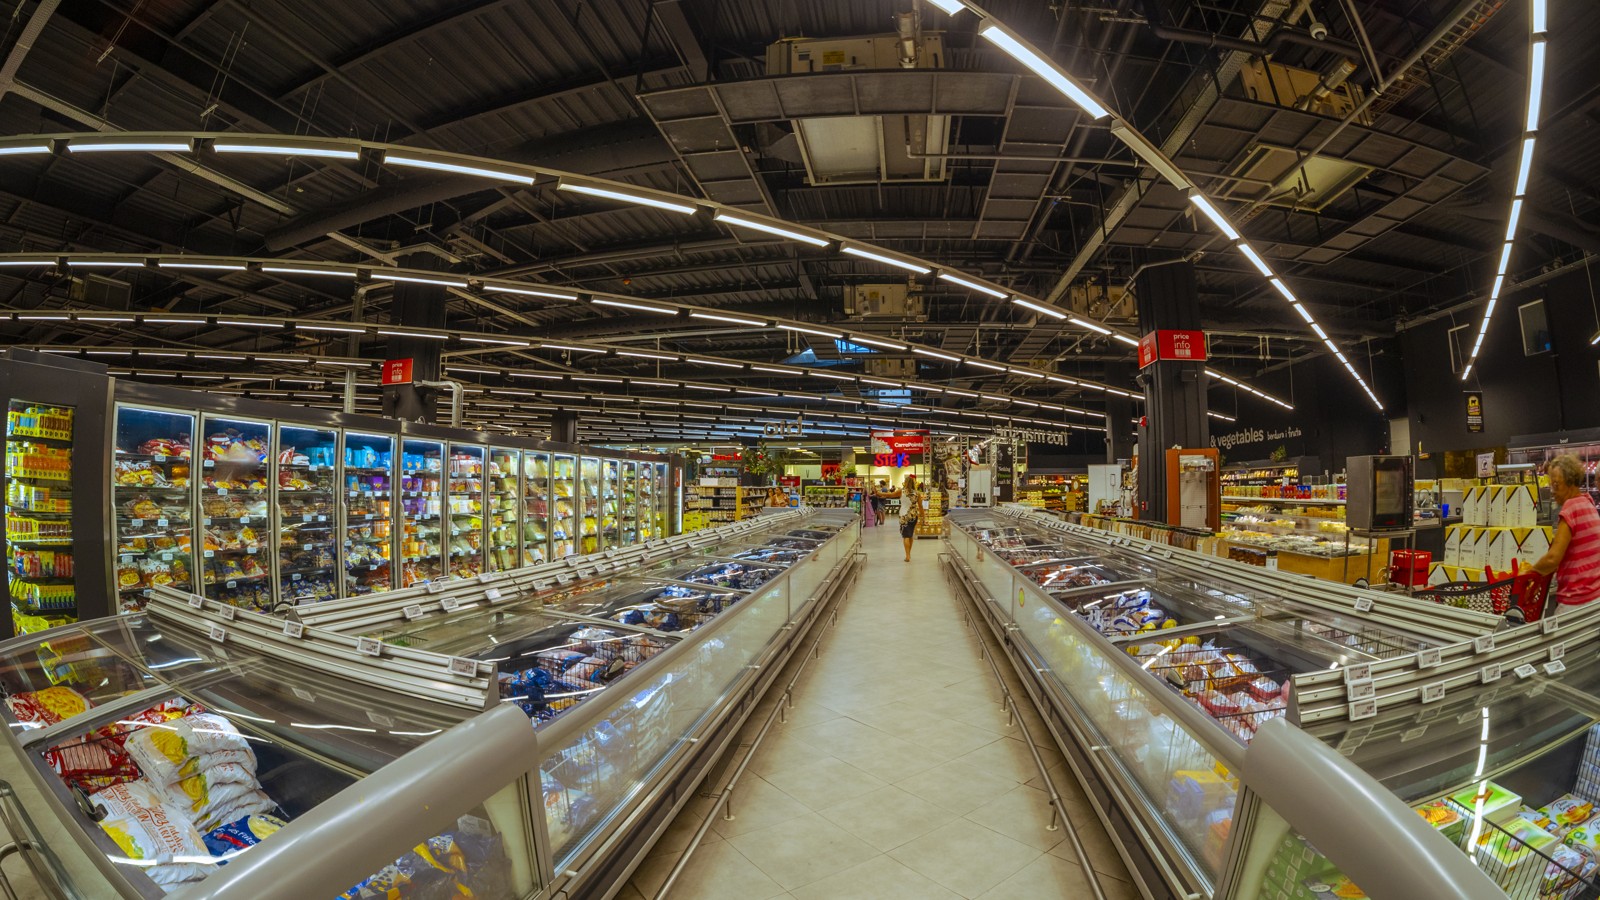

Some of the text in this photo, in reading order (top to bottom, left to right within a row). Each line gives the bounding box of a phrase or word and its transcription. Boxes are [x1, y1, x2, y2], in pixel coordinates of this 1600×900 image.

[1173, 333, 1190, 342] price
[1174, 341, 1191, 349] info
[1210, 434, 1217, 448] &
[1217, 427, 1264, 450] vegetables
